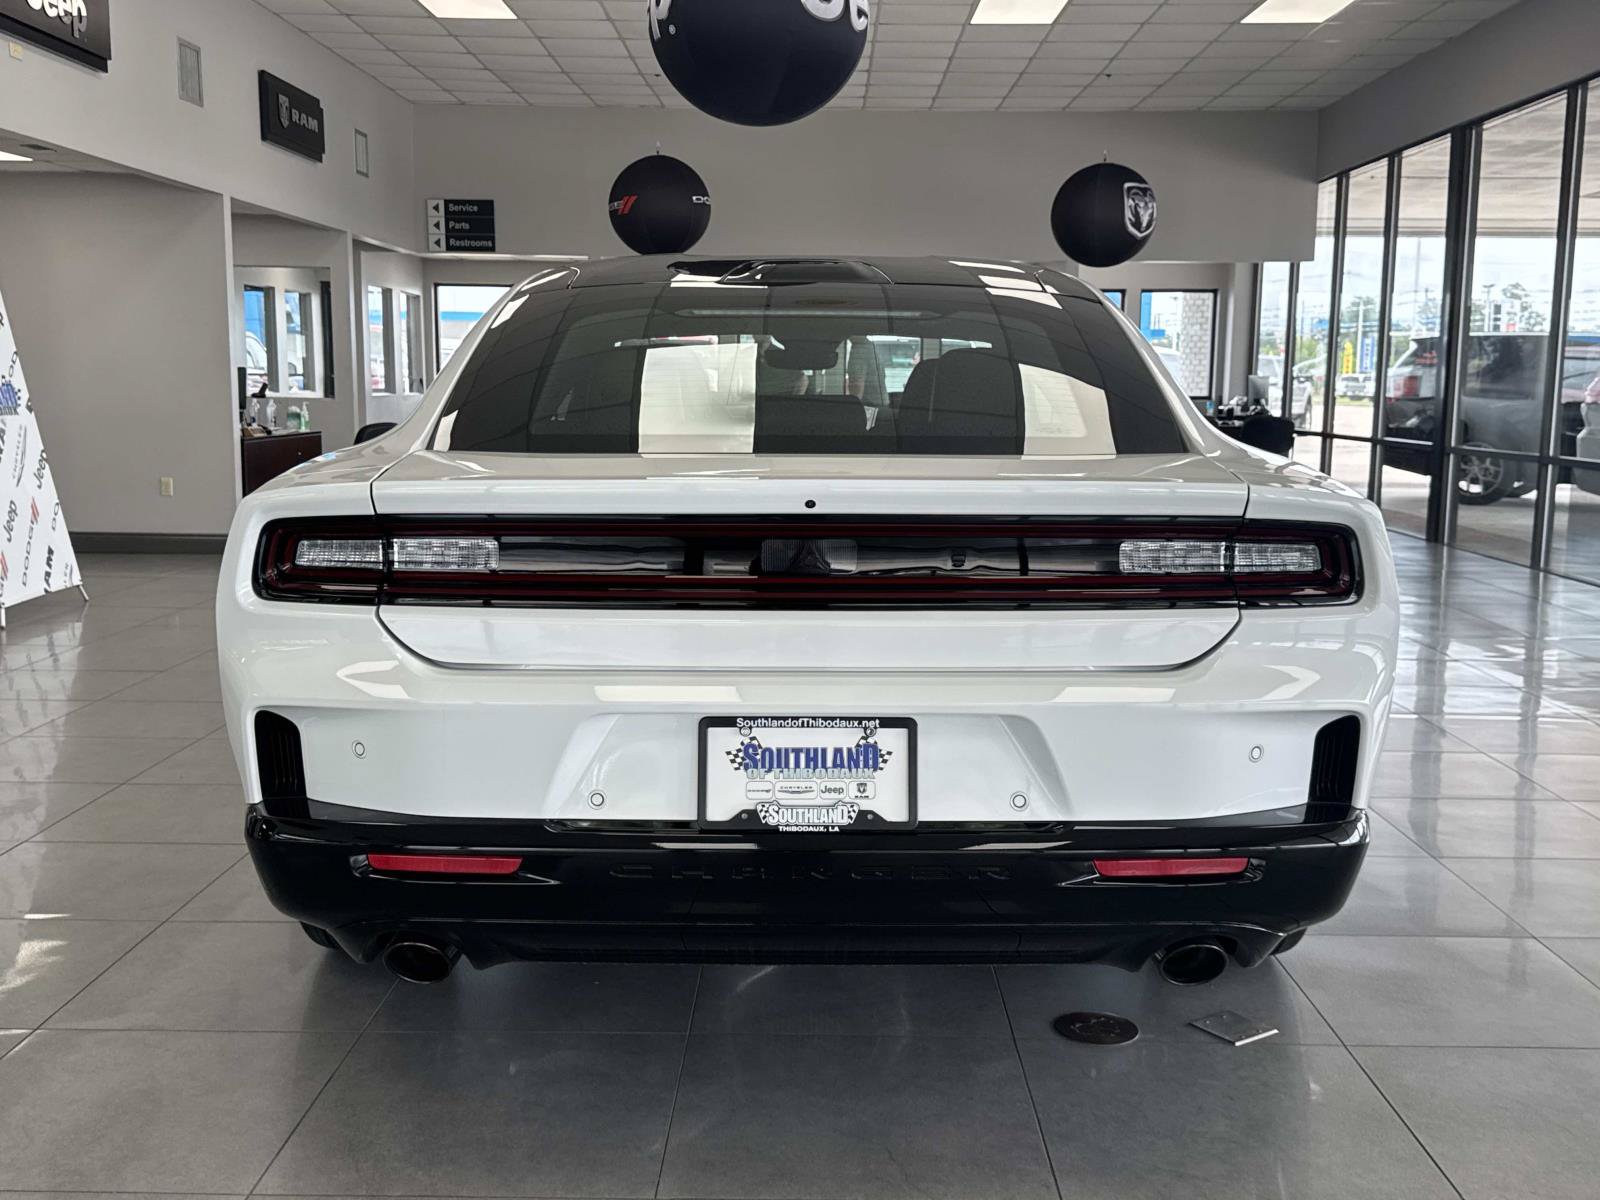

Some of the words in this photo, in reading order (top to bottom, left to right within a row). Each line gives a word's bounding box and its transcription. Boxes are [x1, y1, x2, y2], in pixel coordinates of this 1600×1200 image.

[291, 108, 319, 133] RAM
[448, 203, 479, 212] Service
[449, 221, 470, 230] Parts
[449, 238, 493, 247] Restrooms
[3, 500, 18, 543] Jeep
[736, 717, 880, 729] SouthlandofThibodaux.net
[743, 742, 879, 773] SOUTHLAND
[746, 768, 767, 780] OF
[773, 768, 876, 780] THIBODAUX
[820, 785, 844, 796] Jeep
[767, 803, 850, 825] SOUTHLAND
[777, 825, 827, 833] THIBODAUX,
